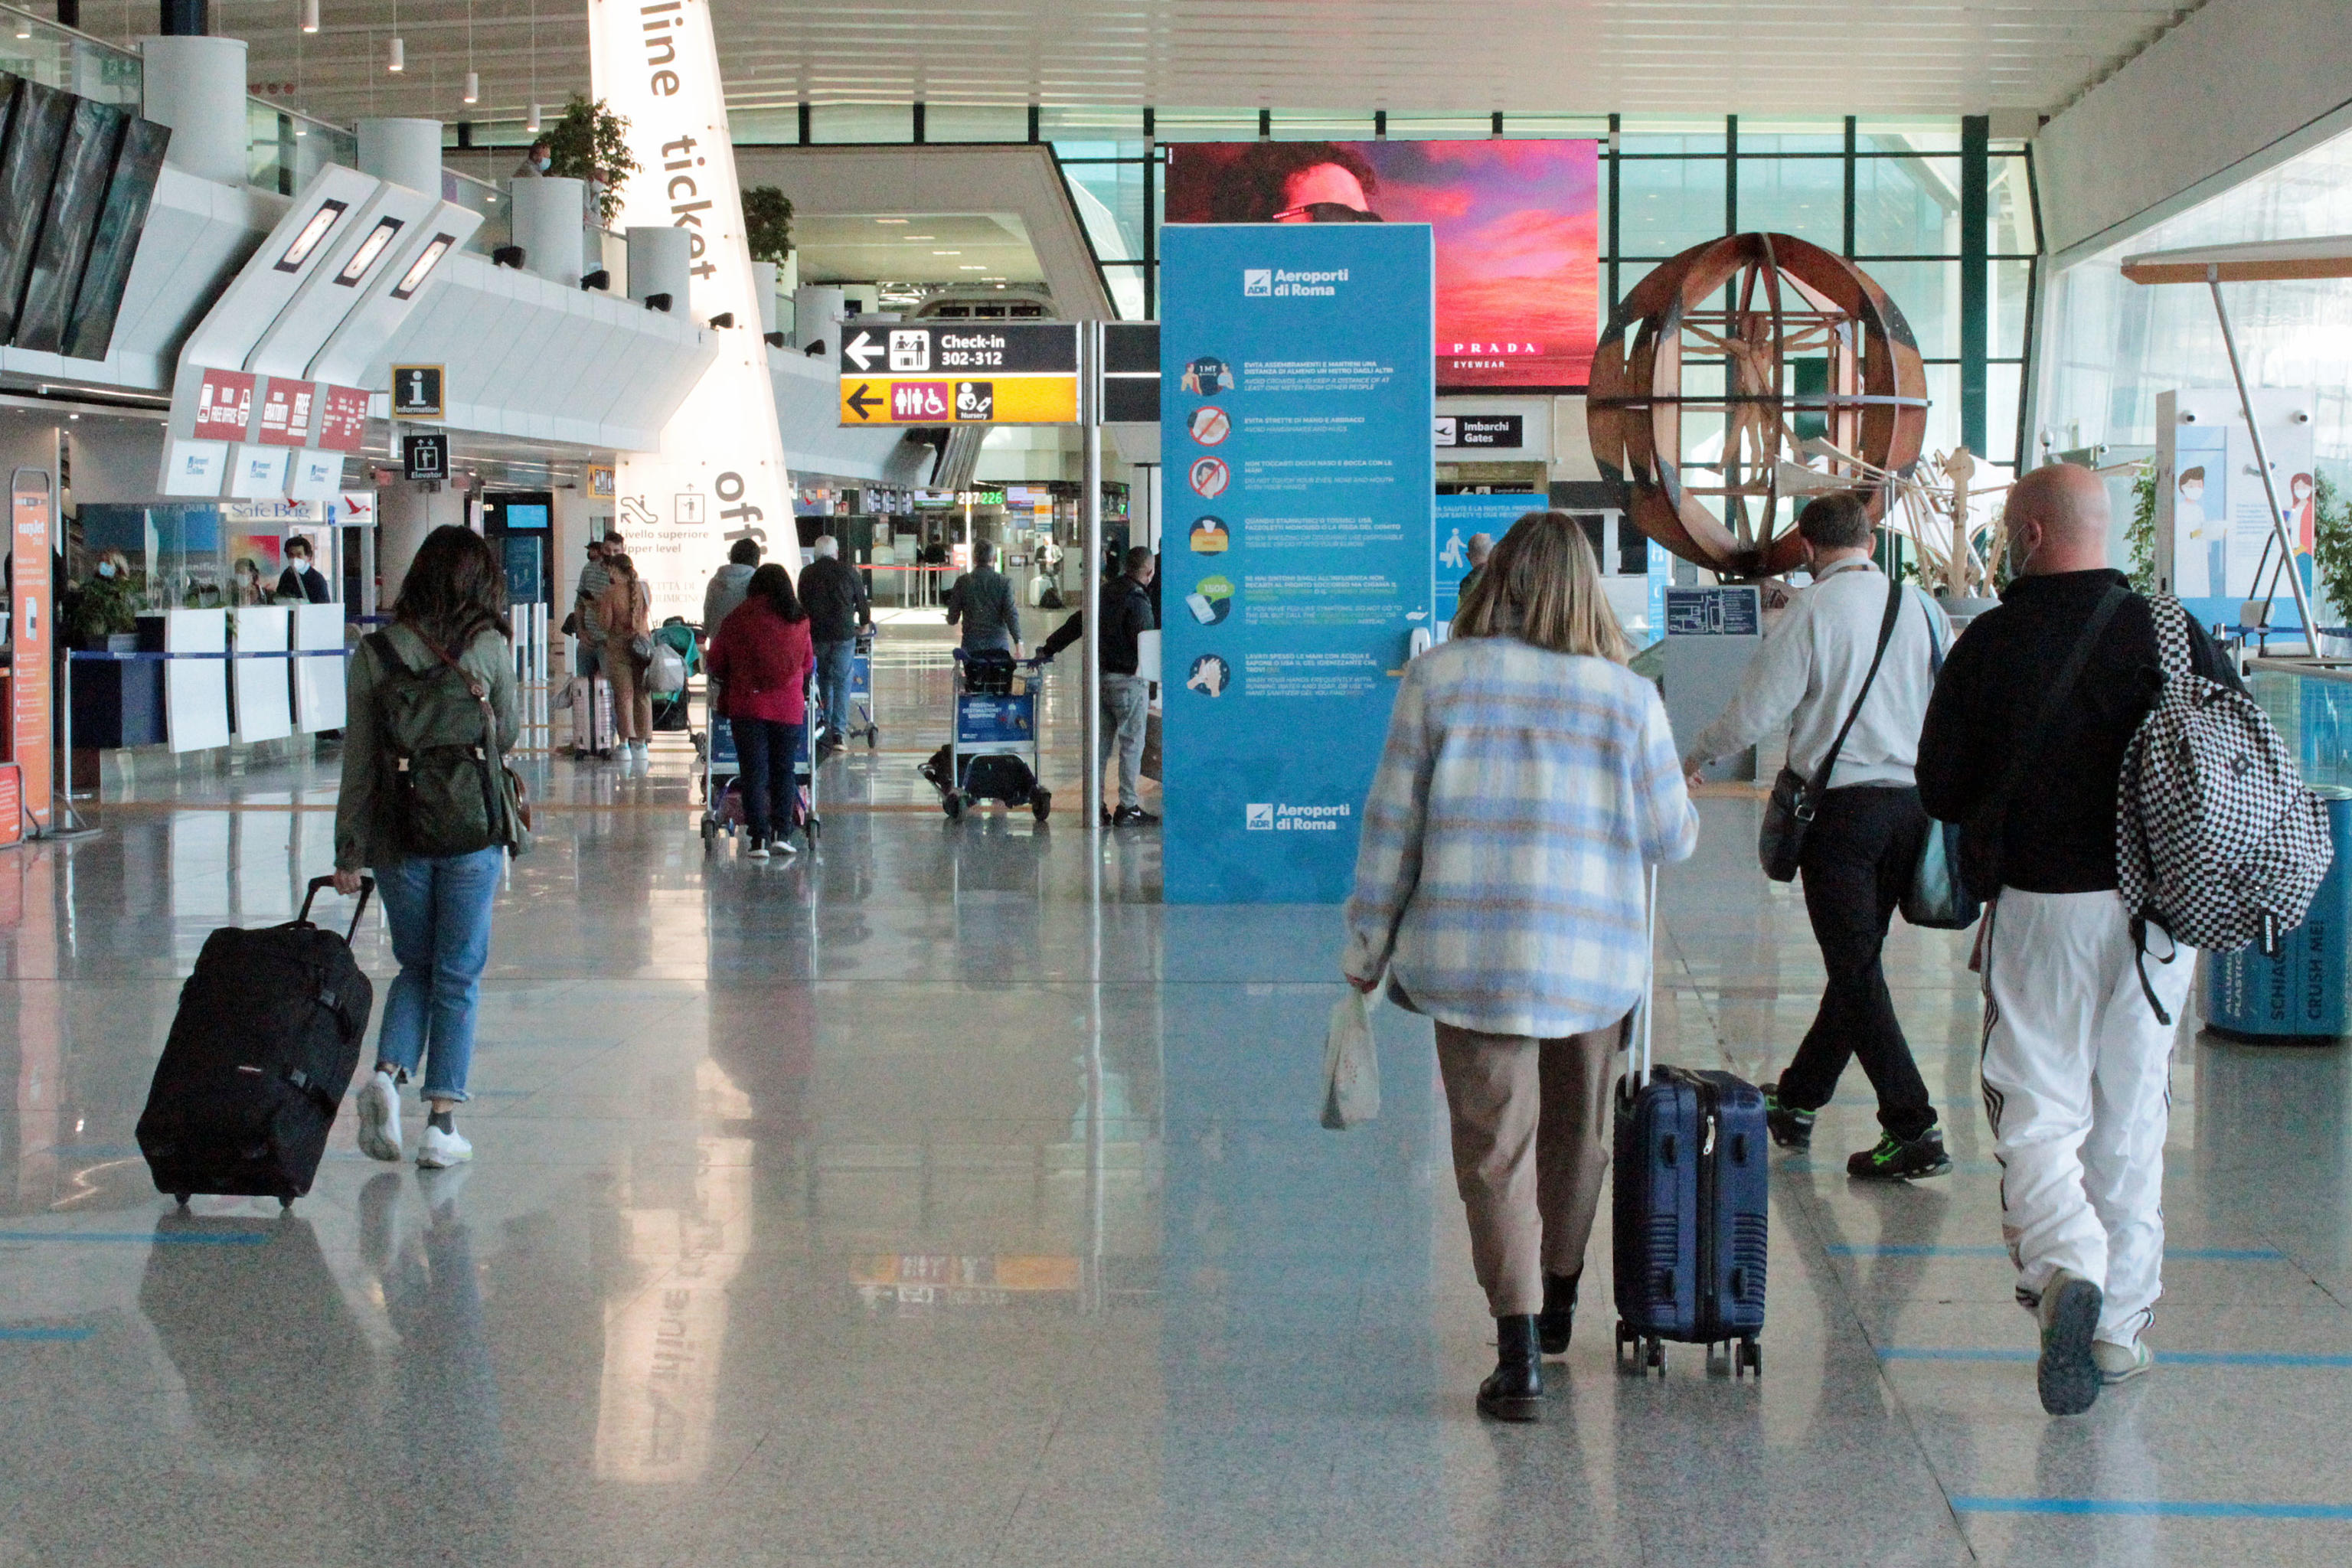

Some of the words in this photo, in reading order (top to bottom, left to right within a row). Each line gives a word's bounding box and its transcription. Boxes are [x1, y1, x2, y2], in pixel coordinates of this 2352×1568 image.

[662, 135, 717, 279] ticket
[1275, 269, 1349, 282] Aeroporti
[1246, 286, 1269, 294] ADR
[1275, 283, 1289, 296] di
[1292, 284, 1335, 296] Roma
[941, 335, 1005, 349] Check-in
[1454, 342, 1535, 353] PRADA
[942, 351, 1002, 365] 302-312
[396, 406, 440, 414] Information
[1464, 421, 1510, 431] Imbarchi
[1464, 433, 1494, 443] Gates
[958, 491, 980, 505] 27
[981, 491, 1003, 505] 226
[231, 502, 272, 518] Safe
[274, 503, 311, 521] Bag
[619, 529, 655, 539] Livello
[658, 529, 710, 541] superiore
[656, 544, 681, 553] level
[684, 581, 694, 590] DI
[1204, 584, 1227, 593] 1500
[1276, 803, 1351, 818] Aeroporti
[1276, 818, 1291, 830] di
[1293, 818, 1336, 830] Roma
[2309, 920, 2324, 952] ME!
[2308, 959, 2323, 1020] CRUSH
